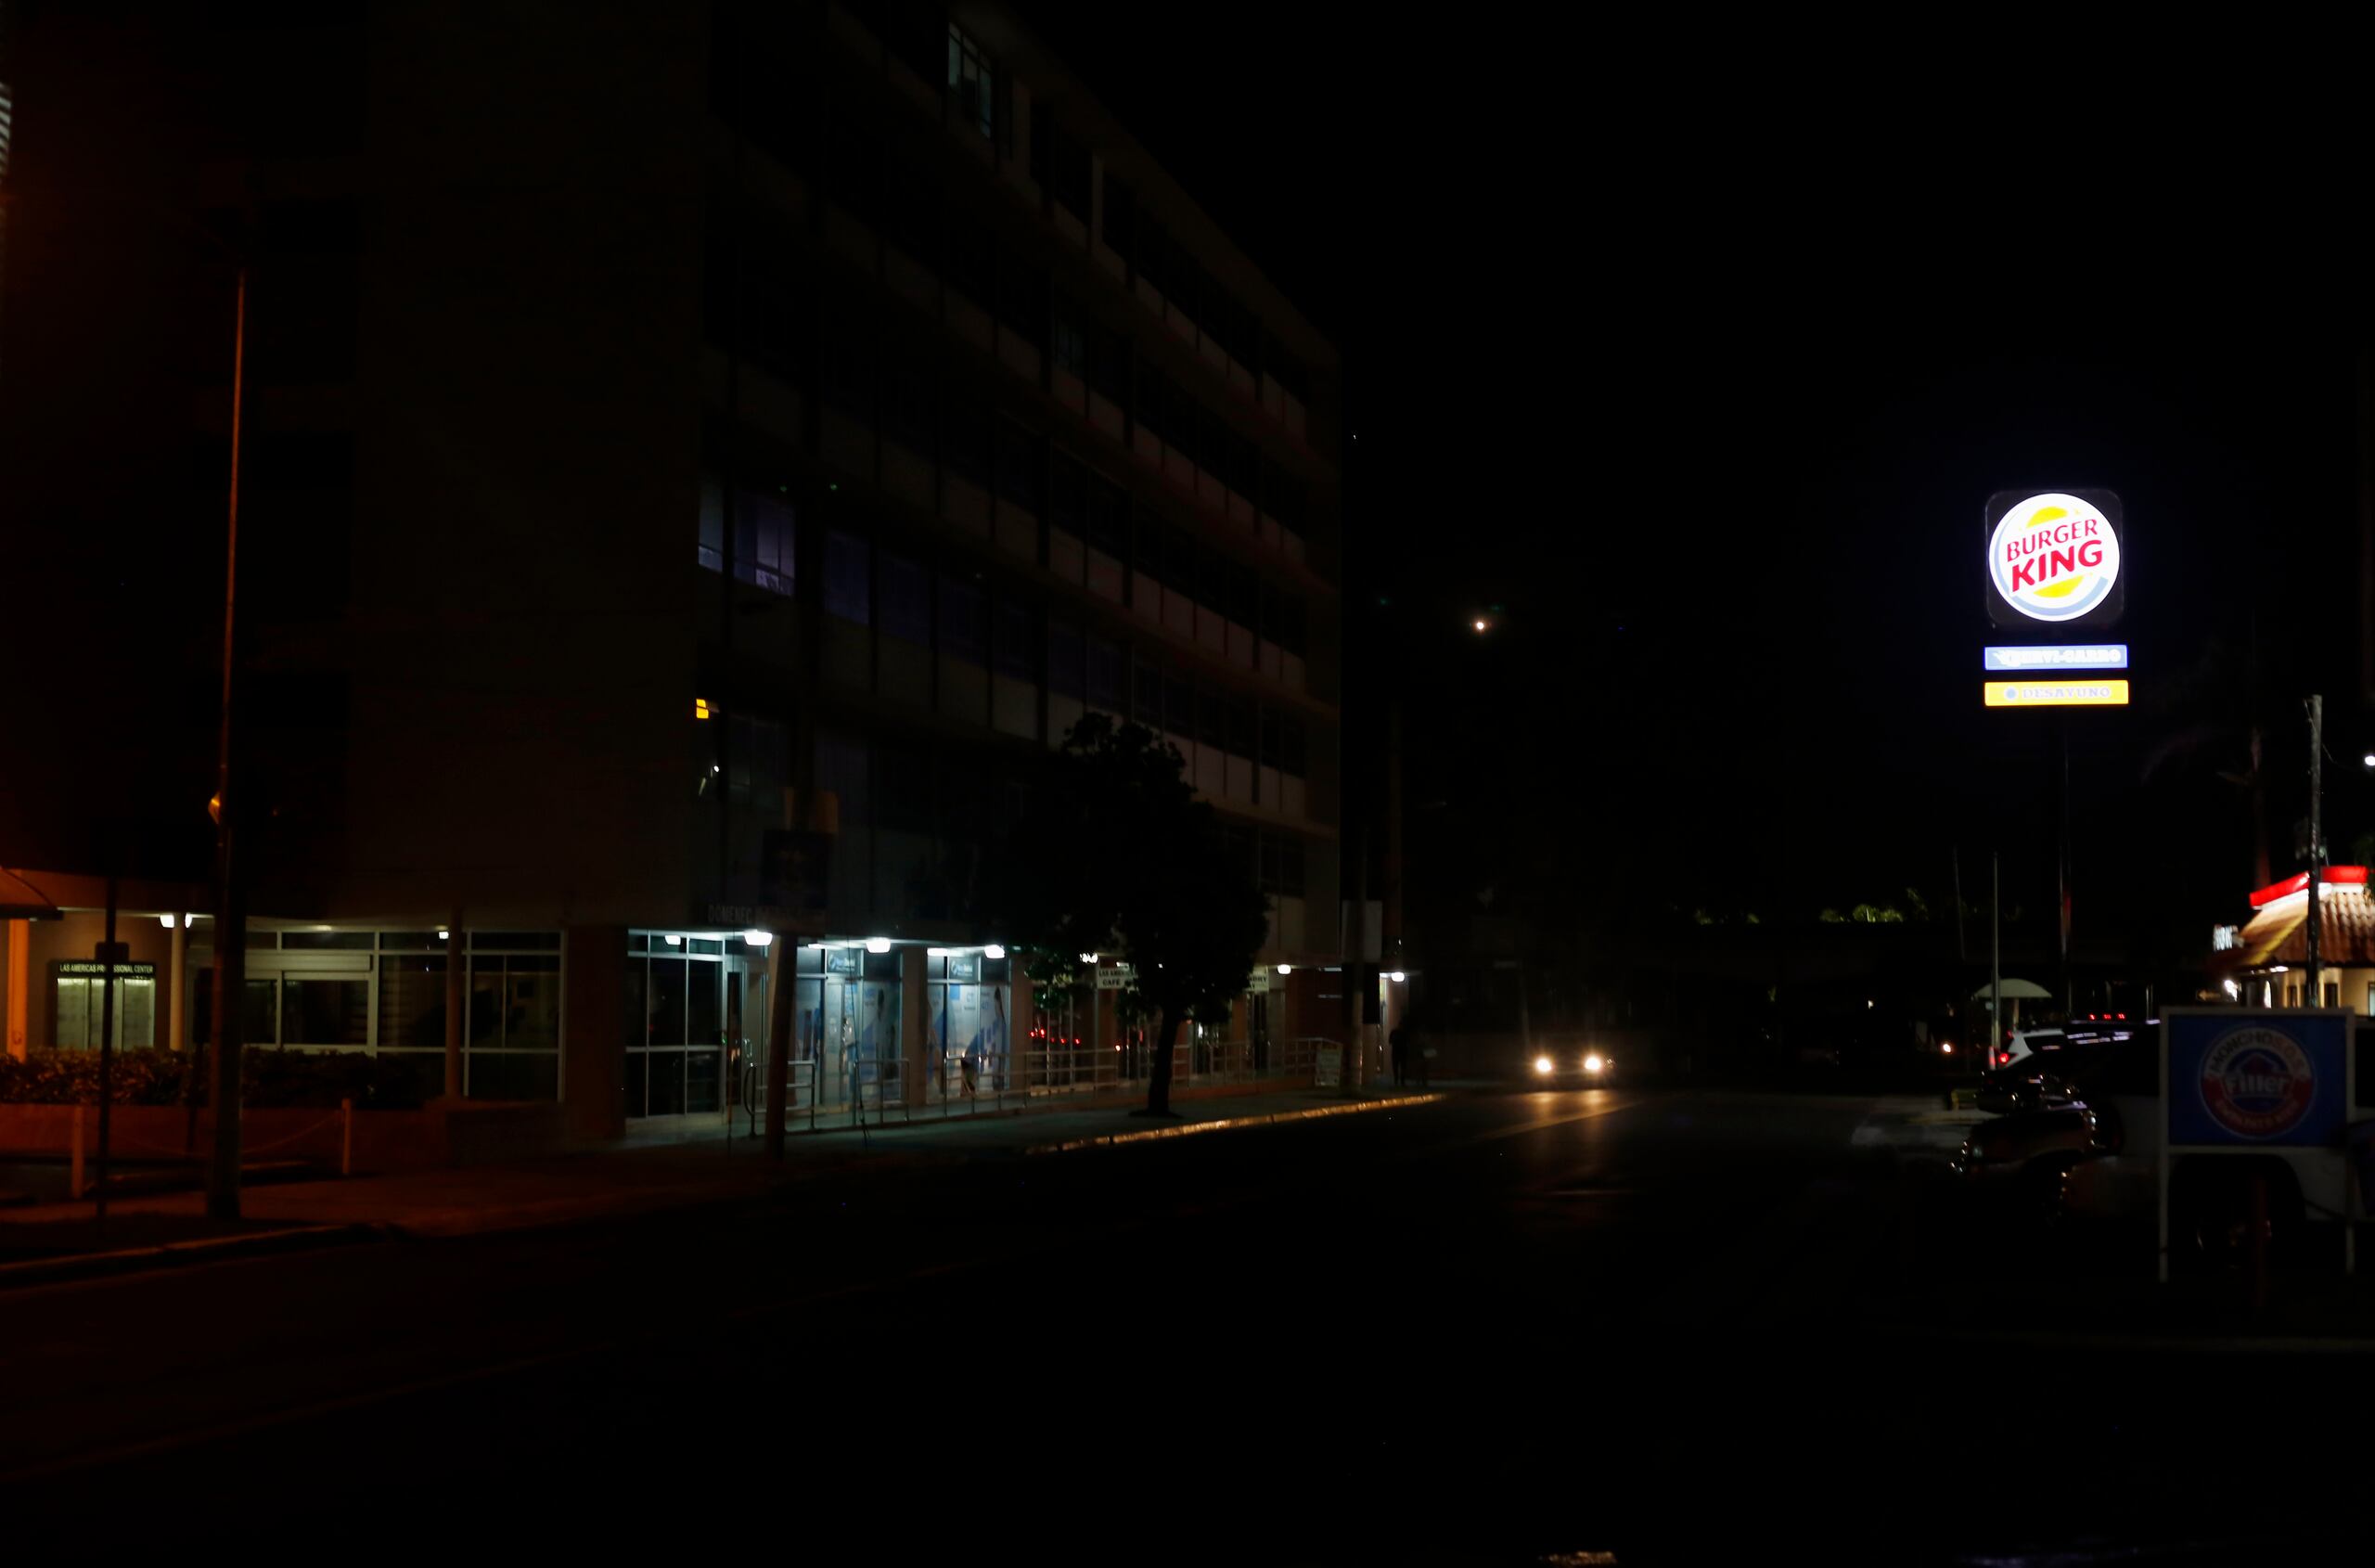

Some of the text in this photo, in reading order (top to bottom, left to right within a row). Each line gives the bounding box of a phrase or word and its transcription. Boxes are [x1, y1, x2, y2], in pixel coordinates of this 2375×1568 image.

[2007, 519, 2099, 562] BURGER
[2011, 539, 2103, 593] KING
[2022, 688, 2111, 699] DESAYUNO
[96, 963, 134, 973] PRSSIONAL
